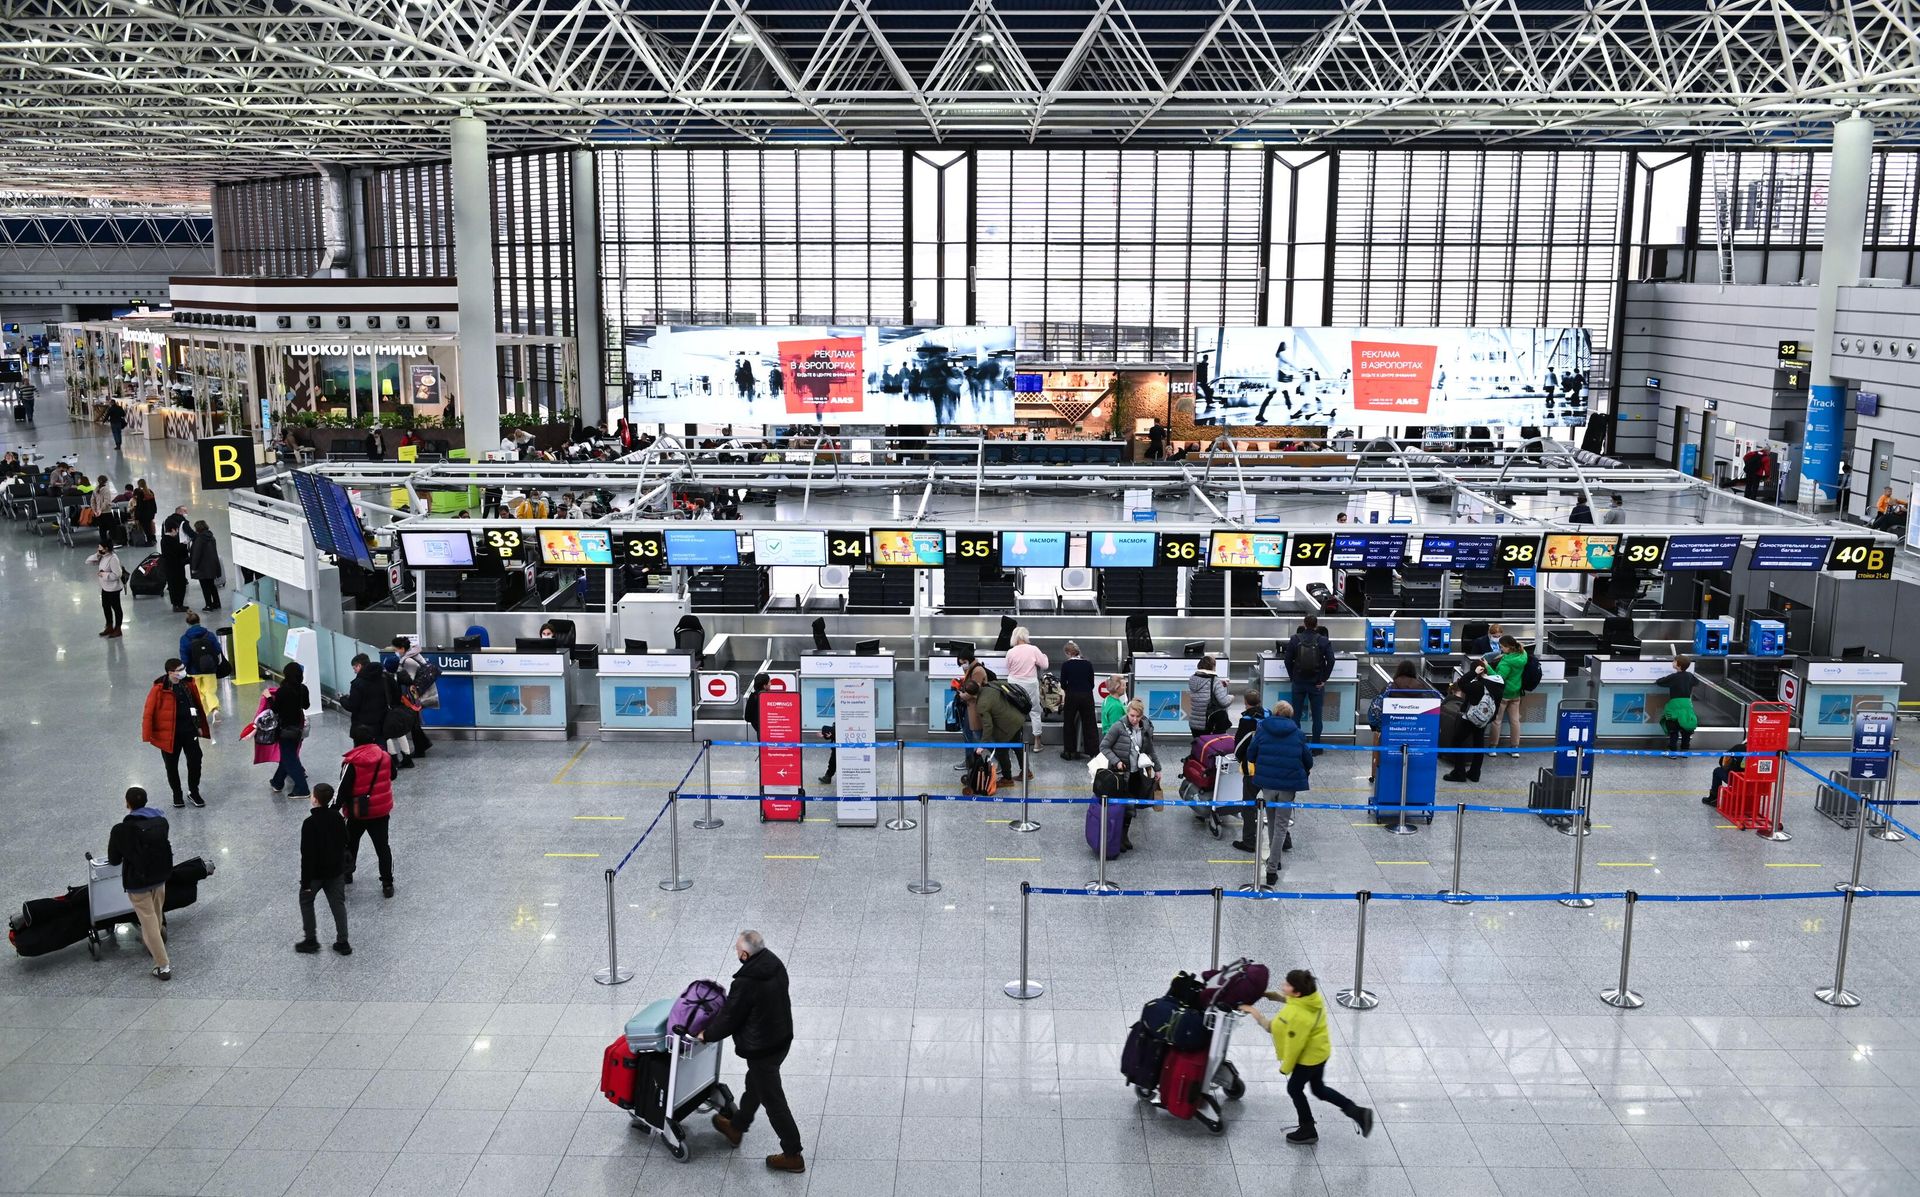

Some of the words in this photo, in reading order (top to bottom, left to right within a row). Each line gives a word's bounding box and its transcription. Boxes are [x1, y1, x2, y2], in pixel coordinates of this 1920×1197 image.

[814, 350, 855, 358] РЕКЛАМА
[1361, 350, 1400, 358] РЕКЛАМА
[1781, 345, 1796, 354] 32
[790, 361, 797, 369] В
[799, 361, 856, 370] АЭРОПОРТАХ
[1361, 361, 1367, 369] В
[1368, 361, 1423, 369] АЭРОПОРТАХ
[213, 445, 242, 482] B
[487, 530, 521, 548] 33
[629, 540, 659, 557] 33
[832, 540, 862, 557] 34
[960, 541, 990, 557] 35
[1165, 542, 1196, 559] 36
[1296, 542, 1326, 559] 37
[1503, 545, 1534, 561] 38
[1627, 546, 1659, 562] 39
[1836, 546, 1868, 563] 40
[438, 656, 469, 668] Utair
